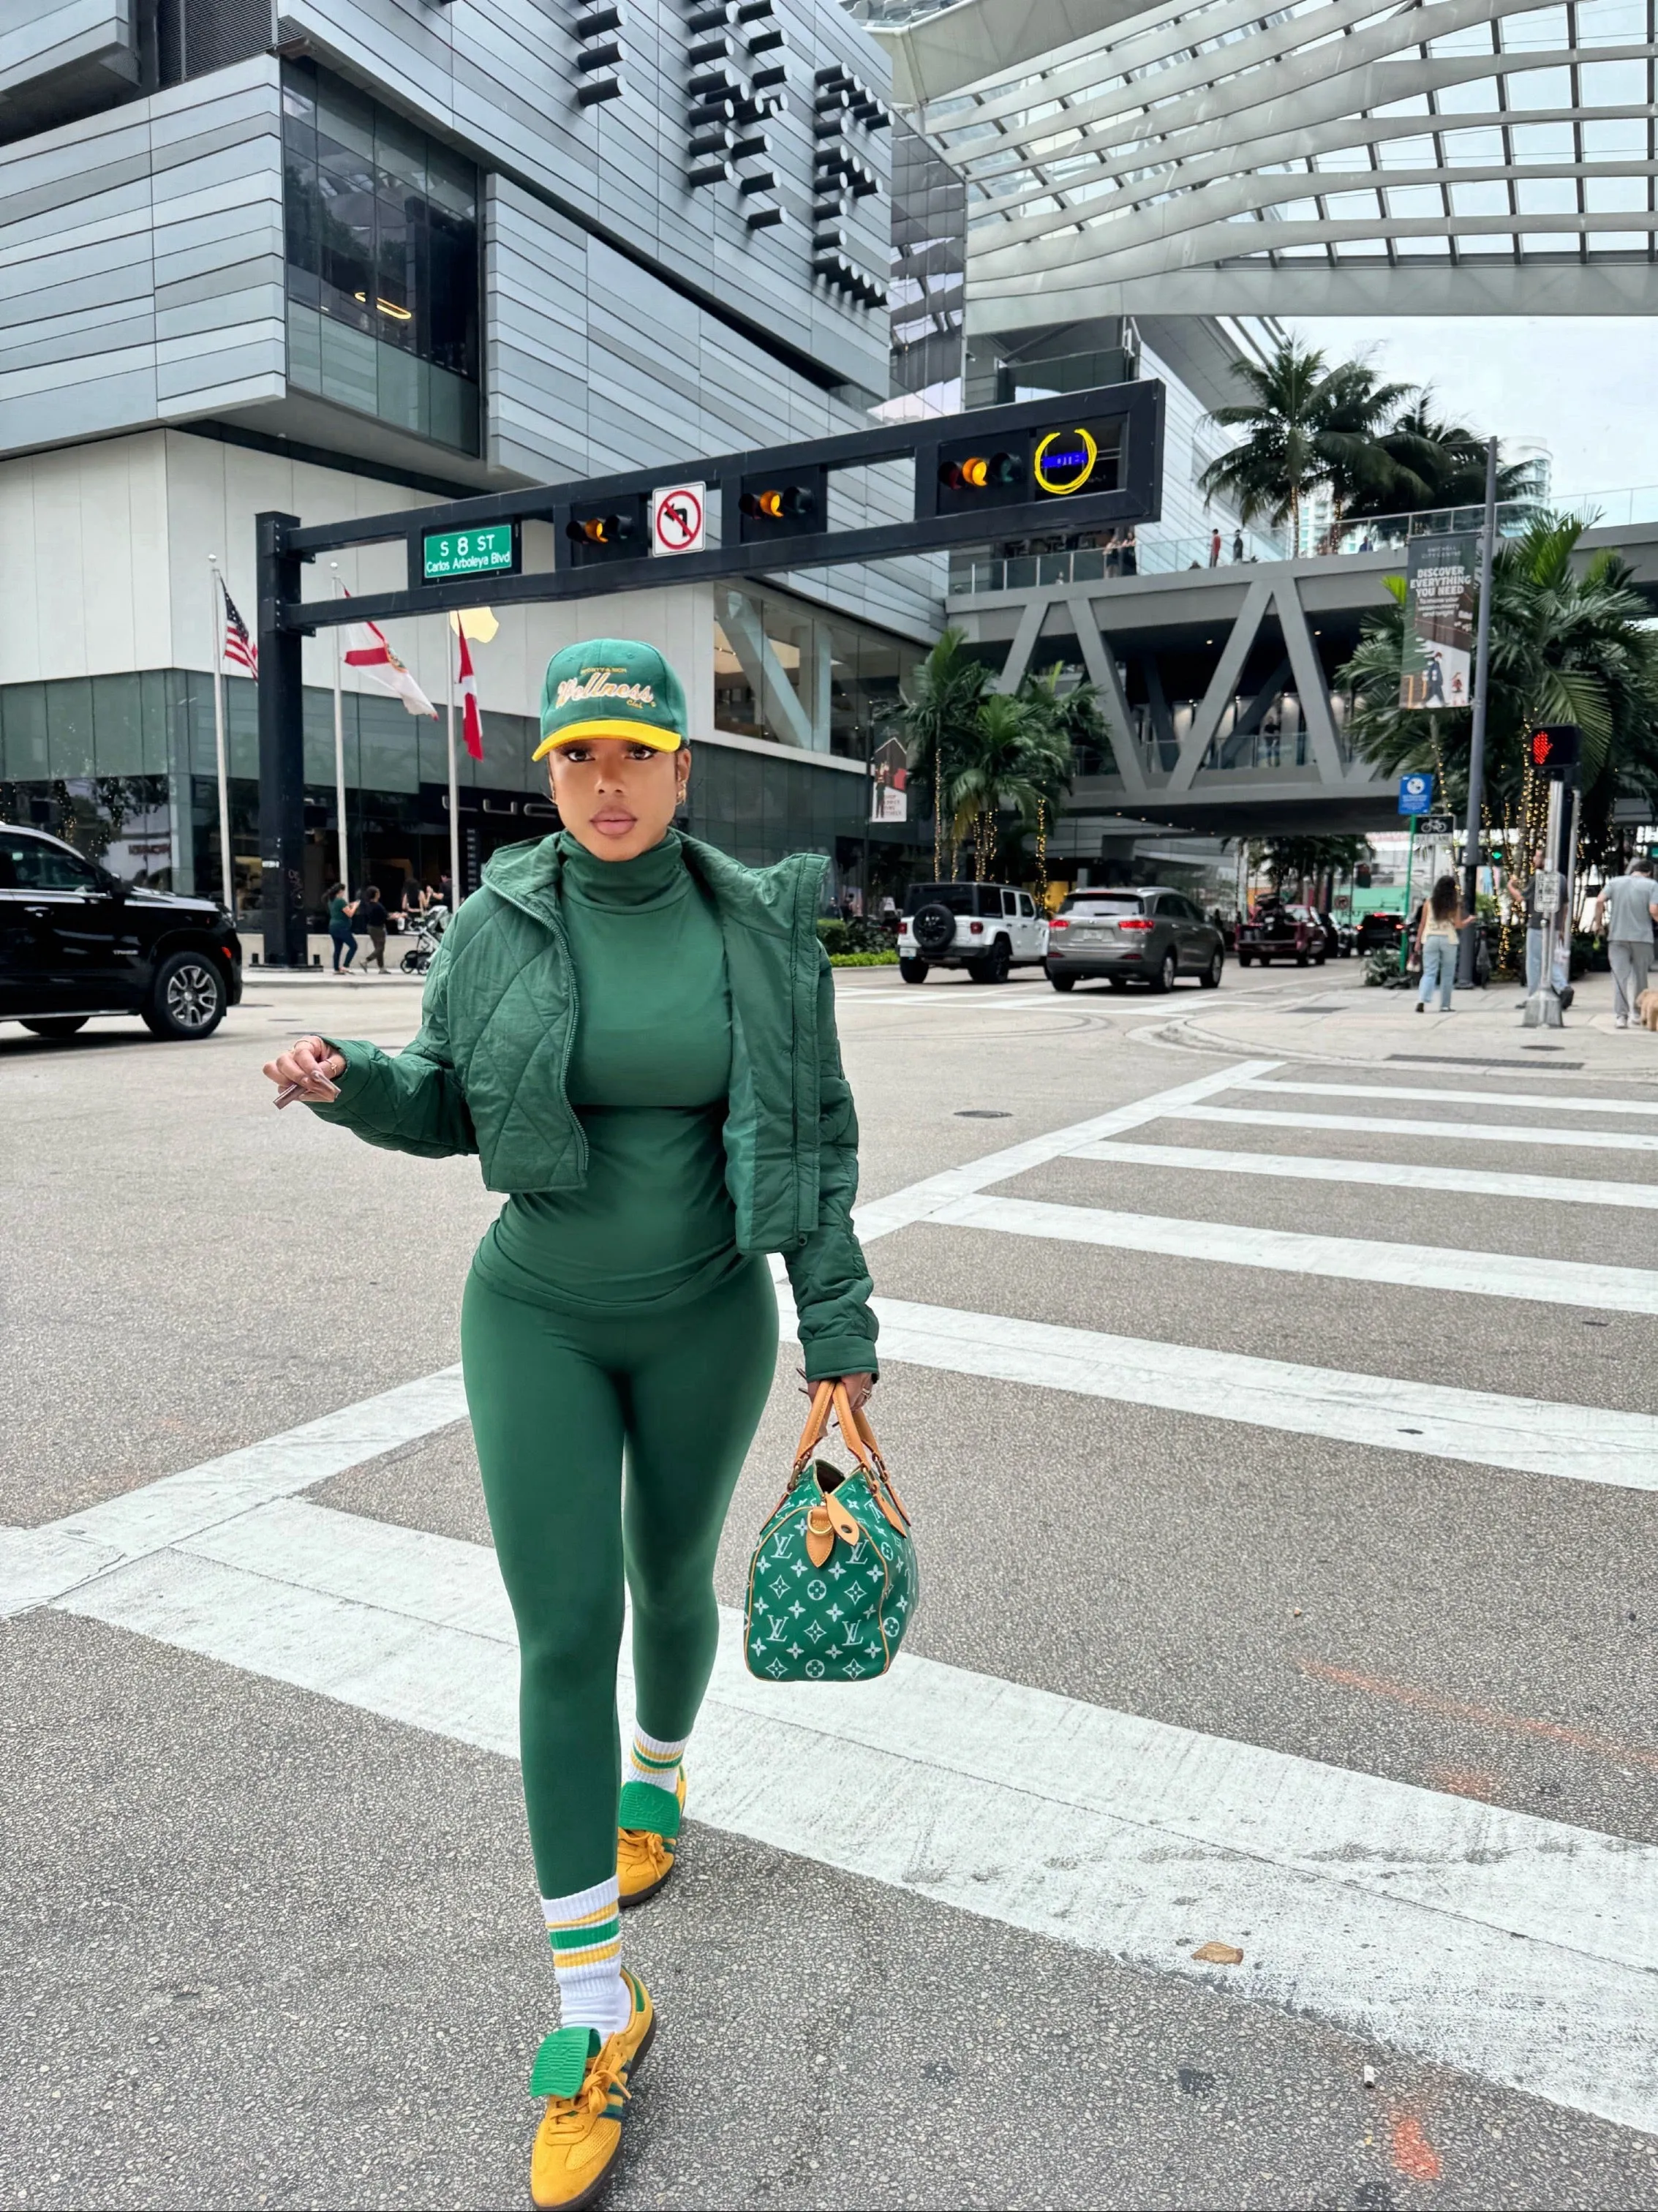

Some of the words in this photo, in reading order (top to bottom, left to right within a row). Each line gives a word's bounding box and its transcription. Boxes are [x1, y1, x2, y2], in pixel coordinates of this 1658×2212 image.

[440, 541, 449, 557] S
[457, 536, 469, 556] 8
[477, 534, 495, 552] ST
[426, 560, 450, 573] Carlos
[452, 556, 489, 570] Arboleya
[491, 551, 510, 565] Blvd
[1417, 566, 1465, 578] DISCOVER
[1410, 576, 1472, 589] EVERYTHING
[1416, 587, 1436, 598] YOU
[1438, 586, 1464, 596] NEED
[555, 672, 654, 710] Wellness
[770, 1532, 795, 1560] LV
[766, 1614, 790, 1642] LV
[841, 1619, 864, 1646] LV
